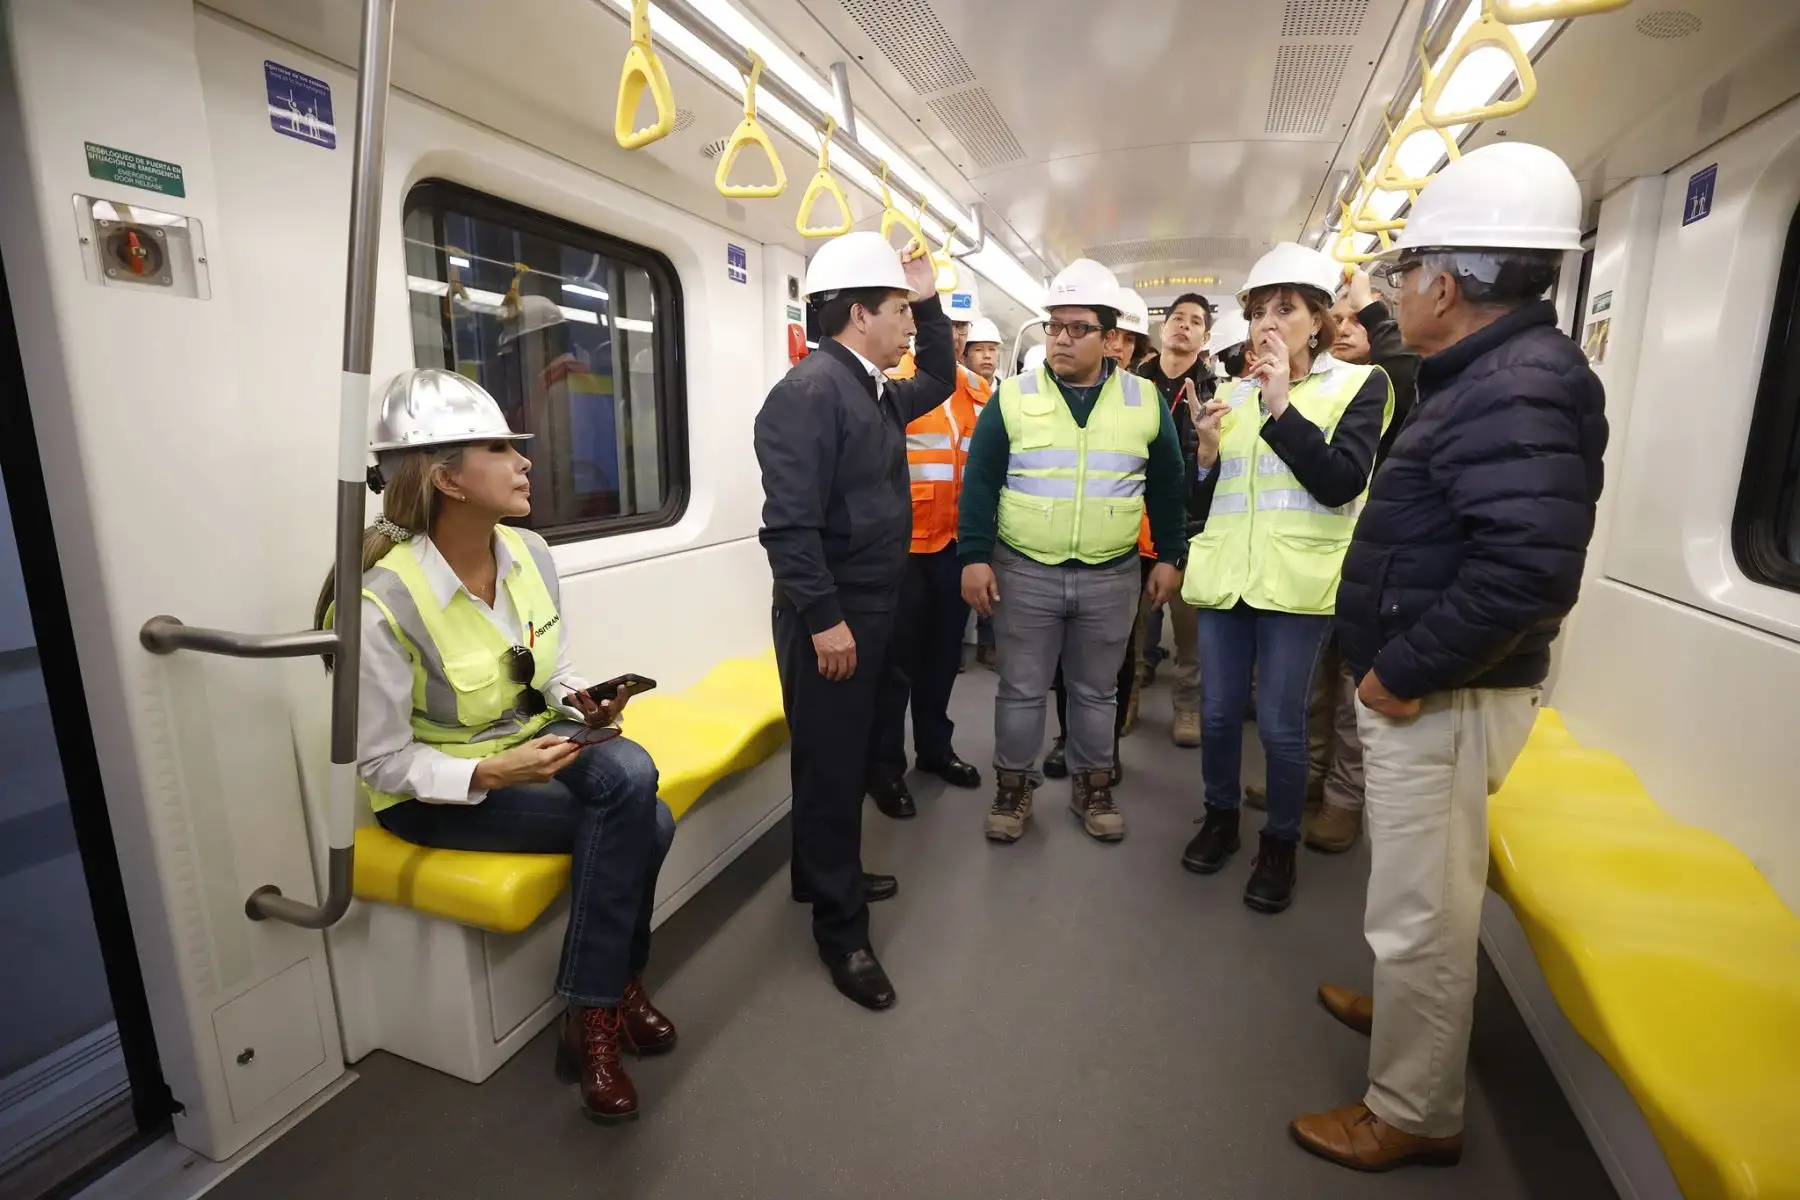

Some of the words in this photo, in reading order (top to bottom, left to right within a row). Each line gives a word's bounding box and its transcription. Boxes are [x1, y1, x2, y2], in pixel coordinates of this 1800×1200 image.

[86, 145, 134, 162] DESBLOQUEO
[135, 157, 145, 165] DE
[146, 160, 171, 171] PUERTA
[117, 168, 158, 181] EMERGENCY
[138, 164, 180, 180] EMERGENCIA
[114, 174, 134, 183] DOOR
[135, 178, 164, 191] RELEASE
[534, 614, 560, 638] OSITRAN
